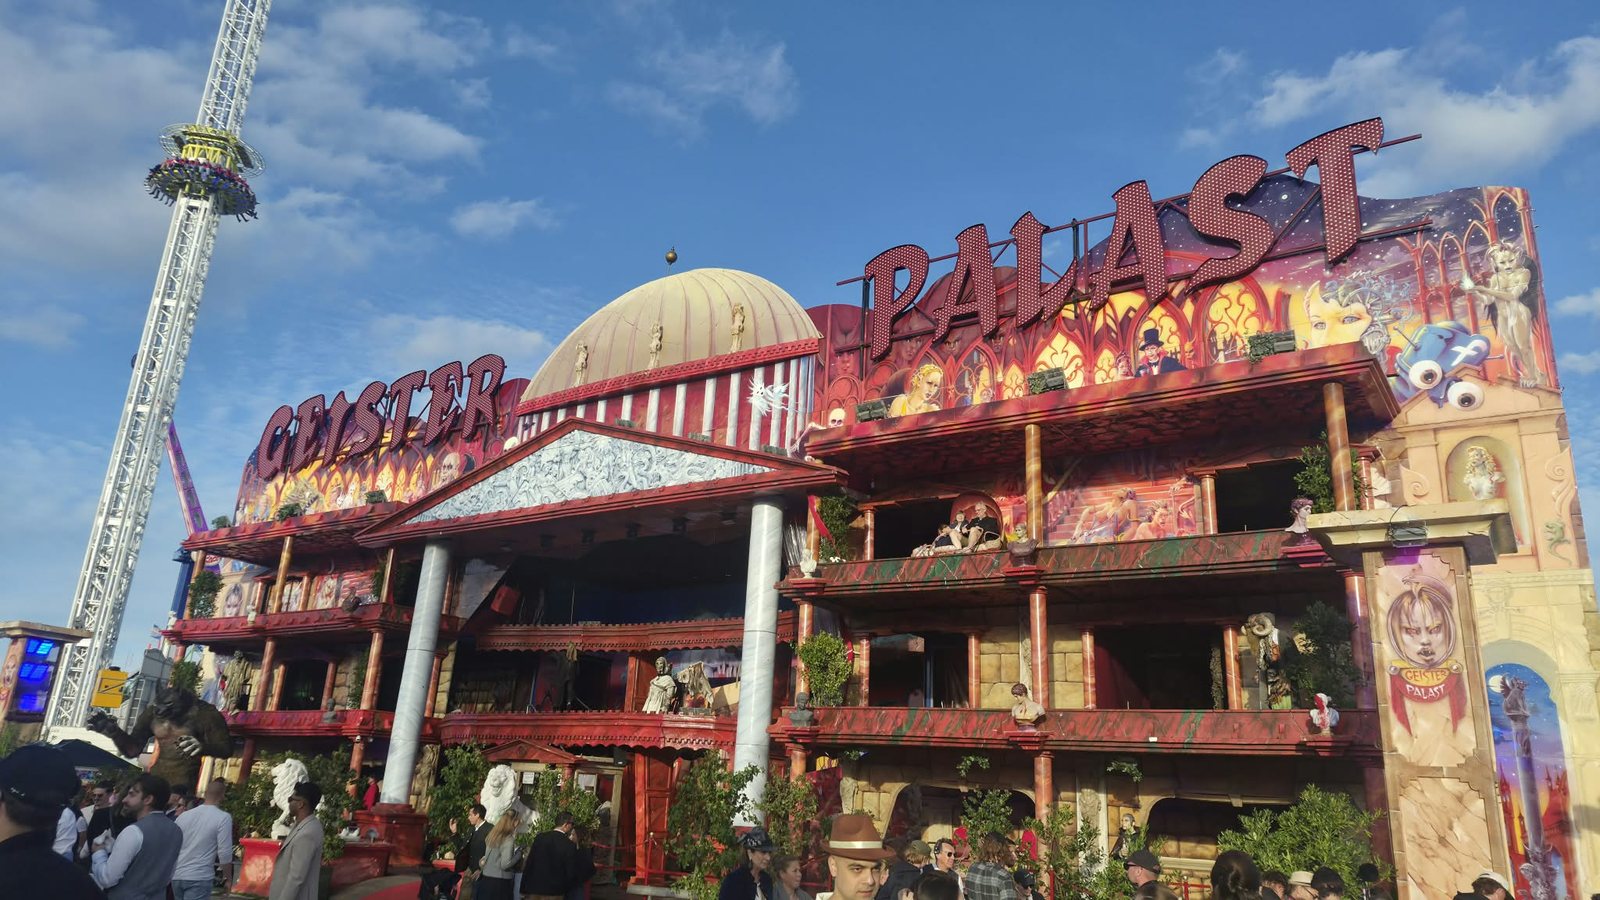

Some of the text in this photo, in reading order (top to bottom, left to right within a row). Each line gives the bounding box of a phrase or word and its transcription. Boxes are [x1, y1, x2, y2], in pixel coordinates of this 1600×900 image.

[257, 116, 1385, 481] GEISTER PALAST
[1405, 669, 1448, 681] GEISTER
[1406, 684, 1445, 699] PALAST
